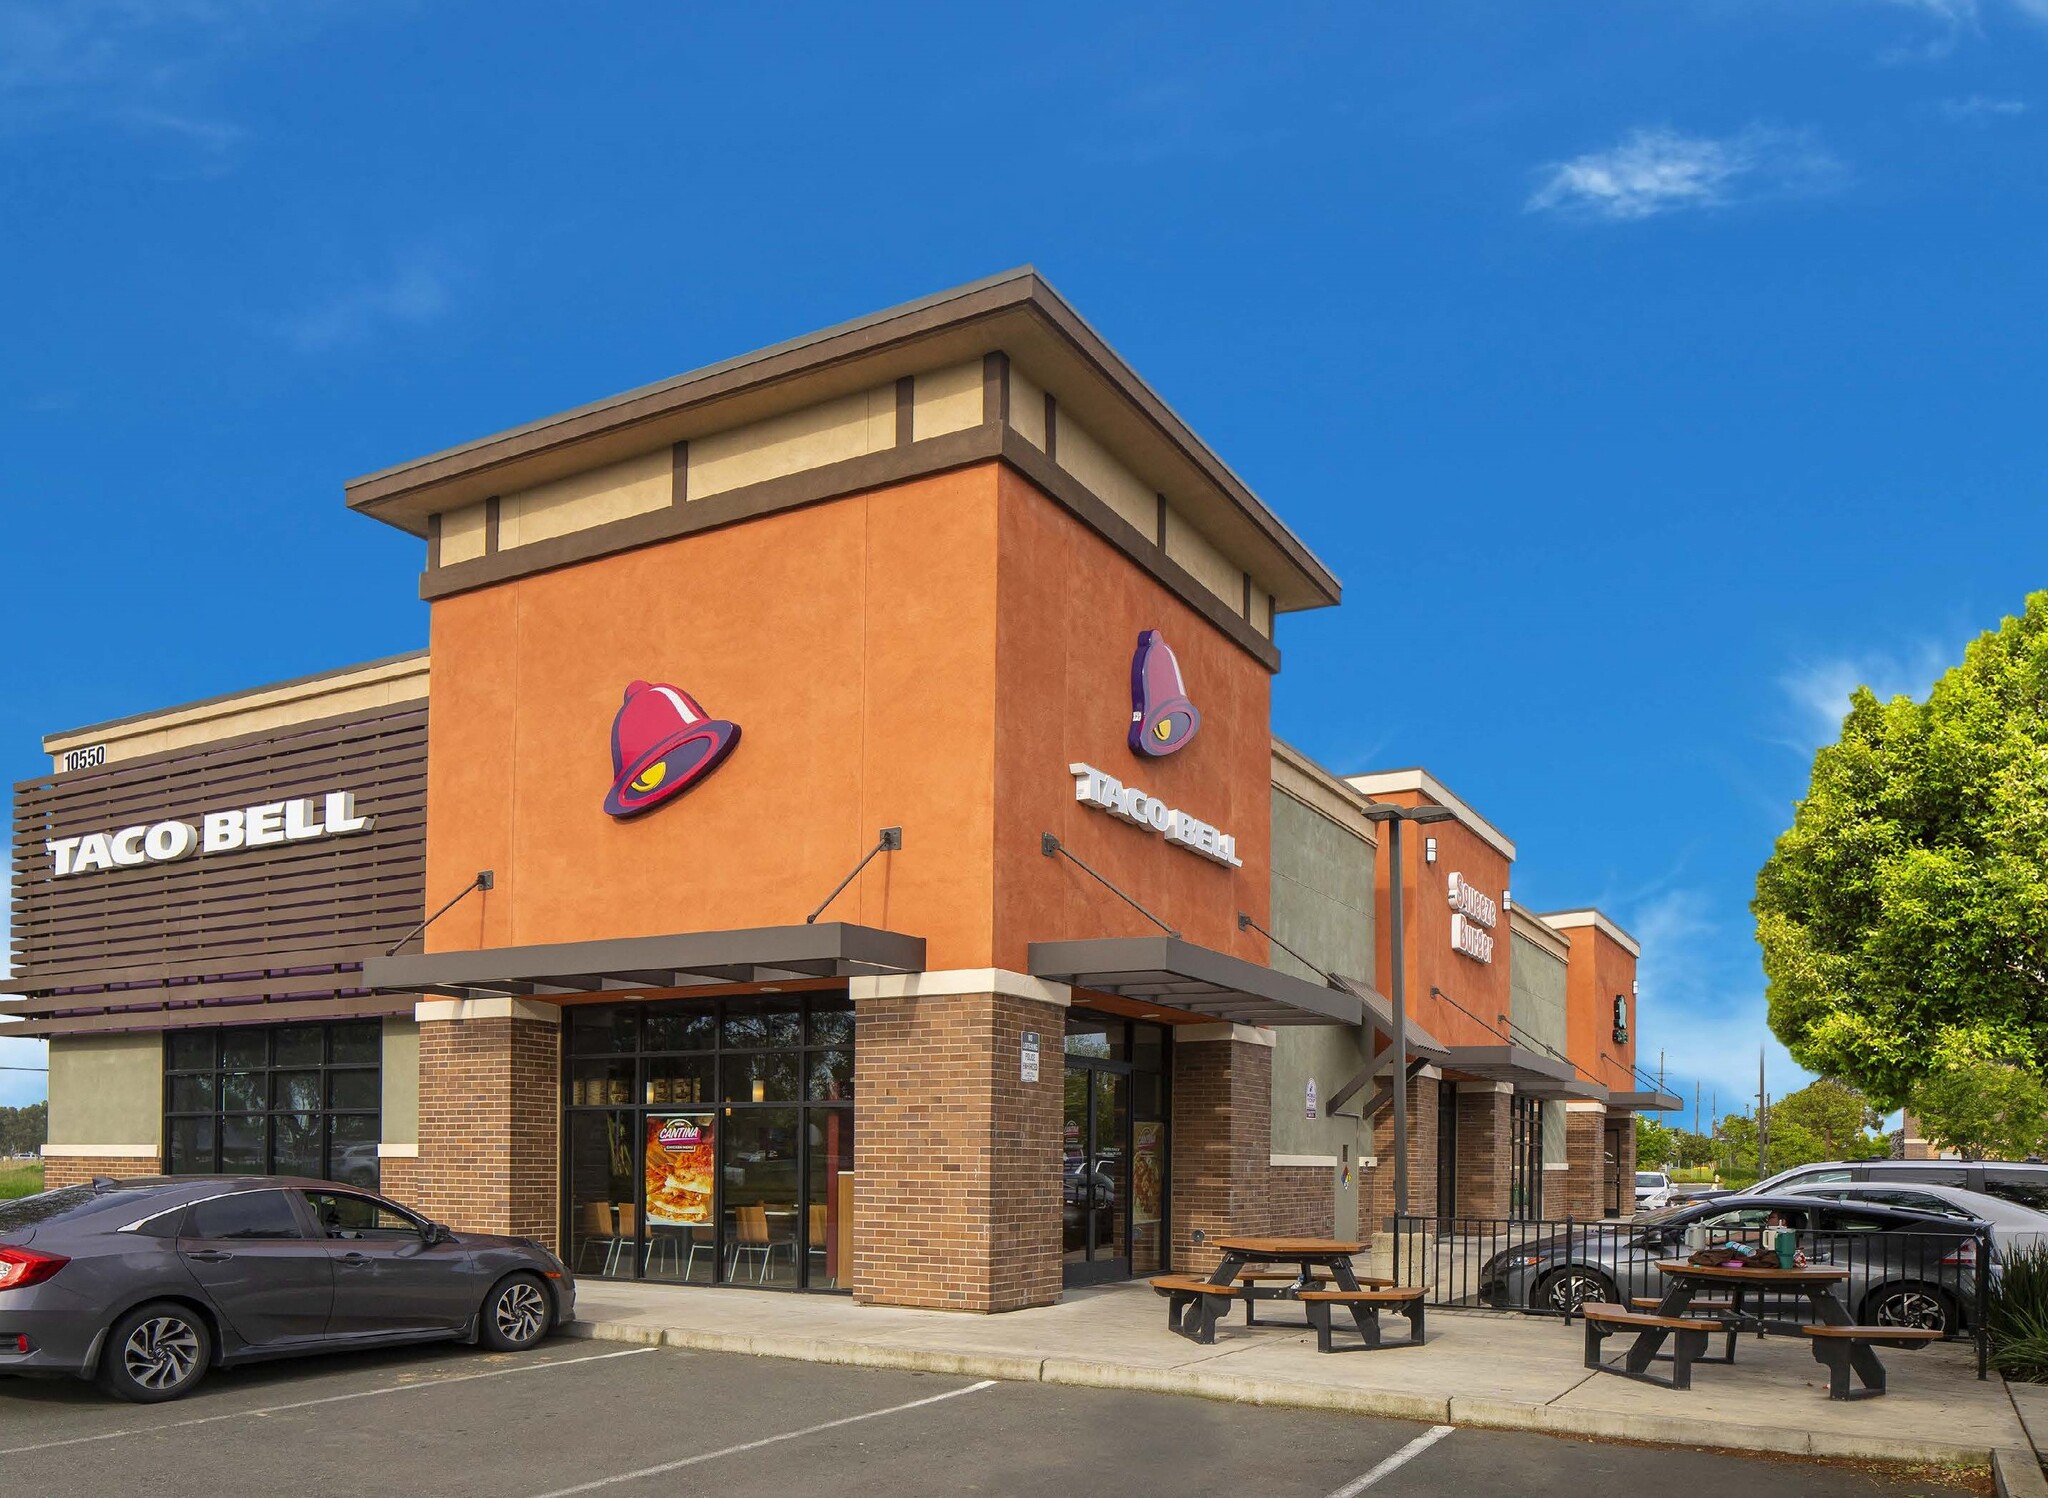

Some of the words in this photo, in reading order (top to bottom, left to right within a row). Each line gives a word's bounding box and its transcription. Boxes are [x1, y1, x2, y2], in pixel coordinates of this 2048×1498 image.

[64, 745, 105, 771] 10550
[46, 820, 198, 876] TACO
[203, 791, 376, 853] BELL
[1068, 762, 1170, 832] TACO
[1165, 808, 1243, 868] BELL
[660, 1127, 699, 1139] CANTINA
